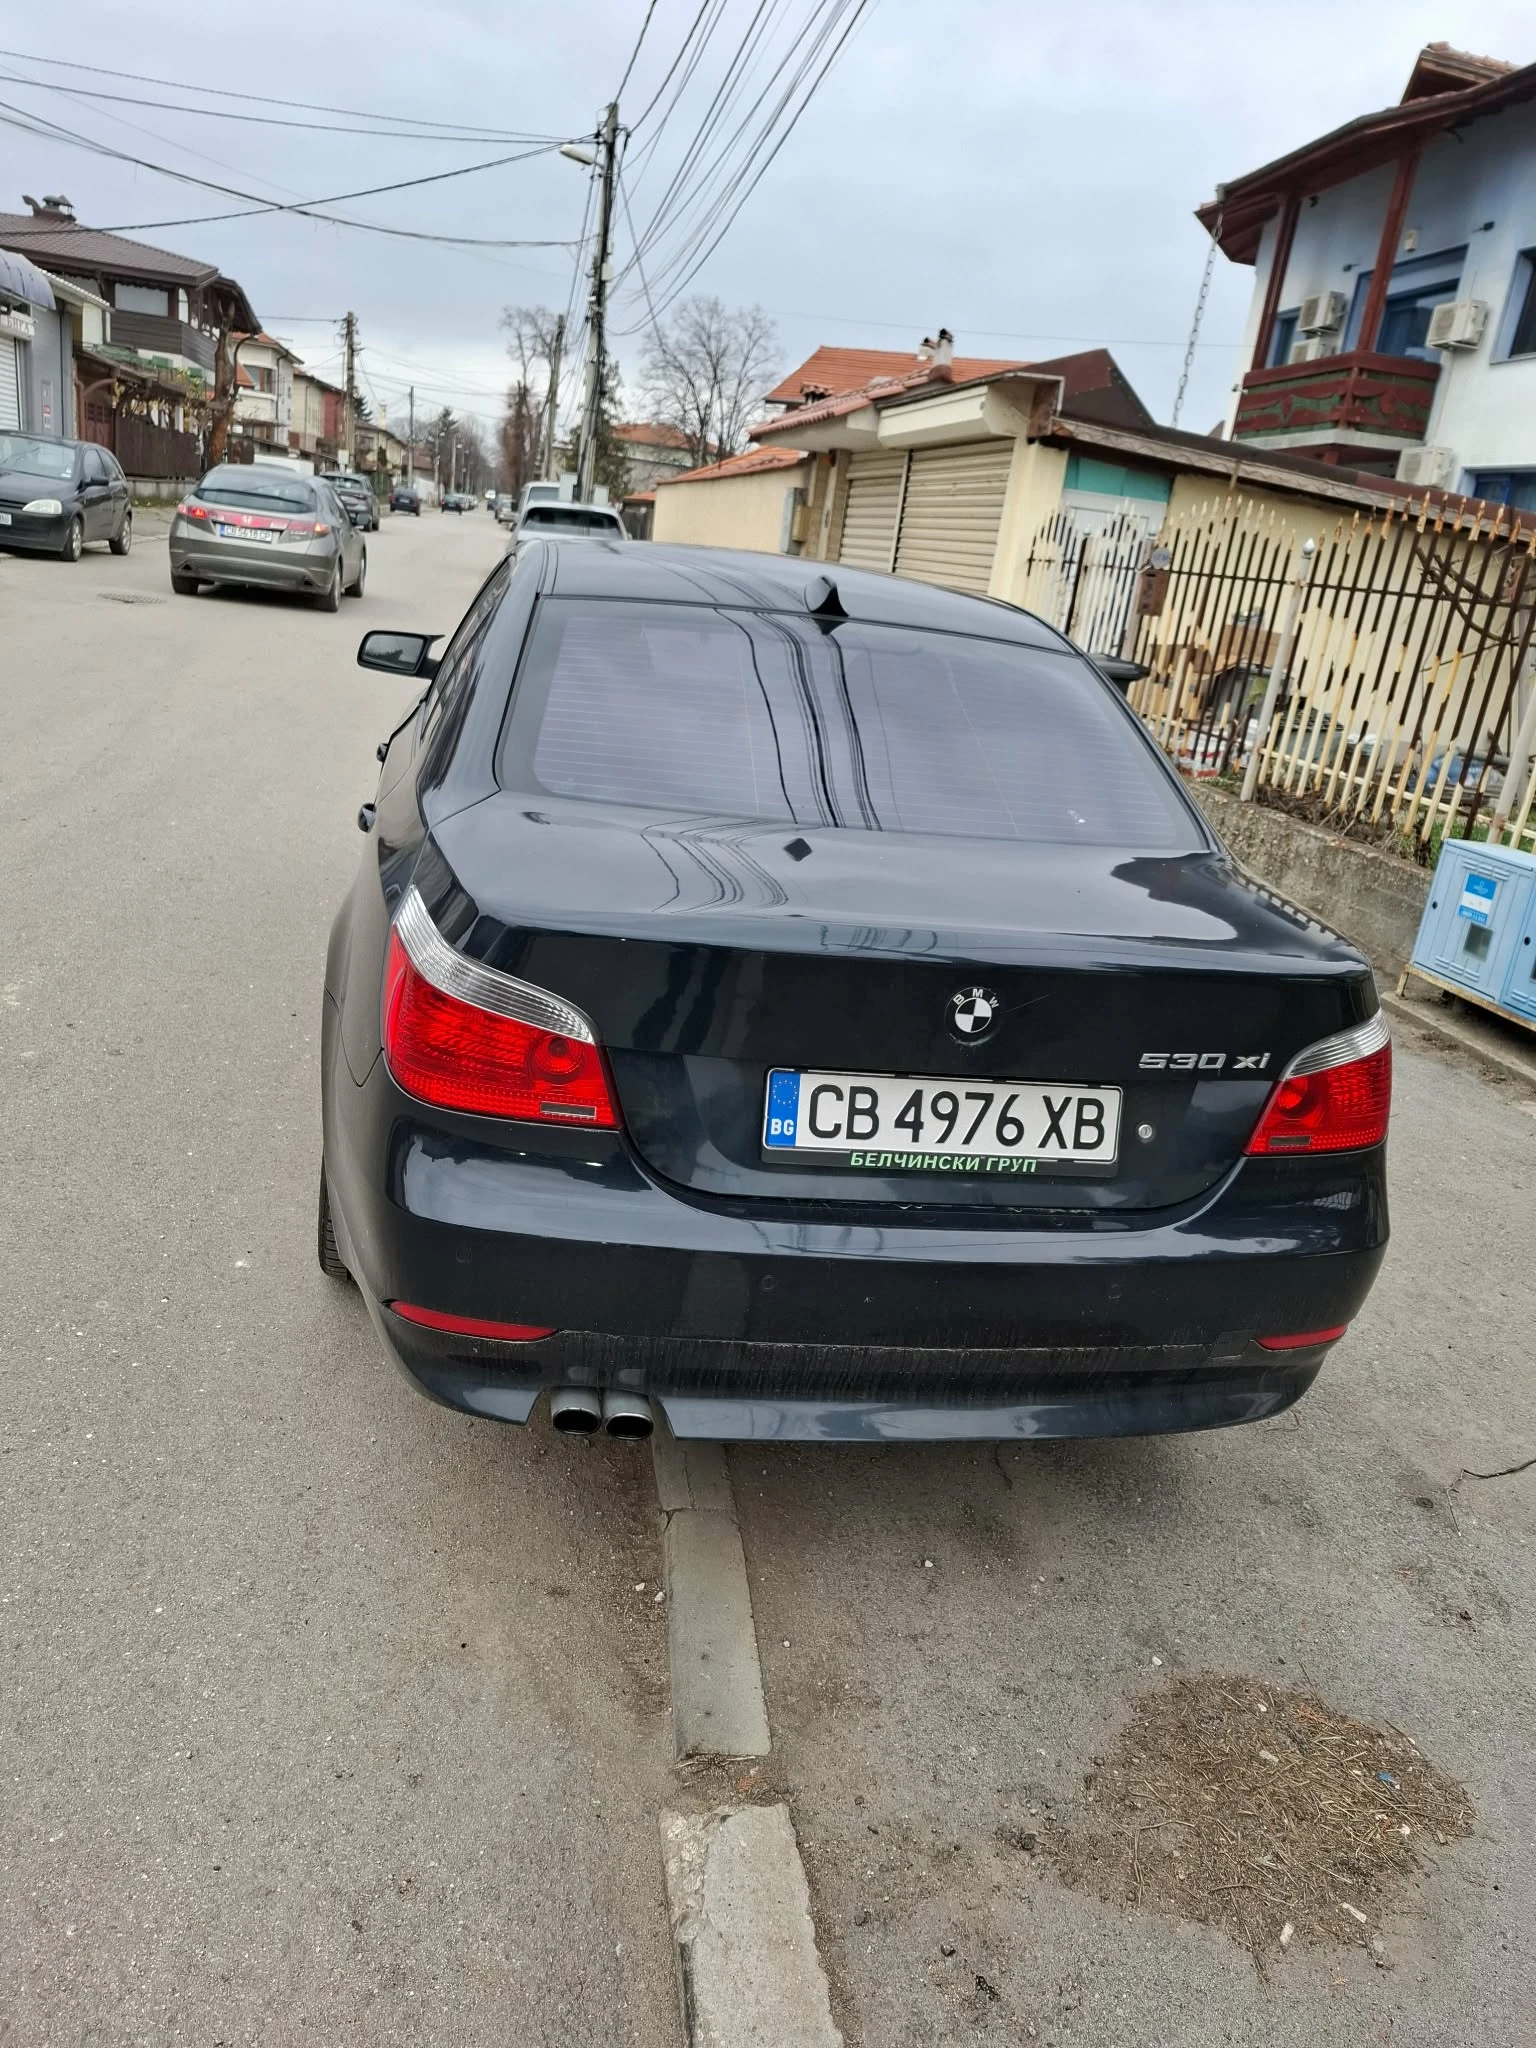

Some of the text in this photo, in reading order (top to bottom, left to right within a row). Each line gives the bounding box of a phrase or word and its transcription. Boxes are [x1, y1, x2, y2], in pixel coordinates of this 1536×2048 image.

[953, 988, 999, 1009] BMW
[1138, 1052, 1271, 1069] 530 xi
[770, 1118, 795, 1136] BG
[809, 1084, 1105, 1150] CB 4976 XB
[850, 1152, 1037, 1173] БЕЛЧИНСКИ ГРУП
